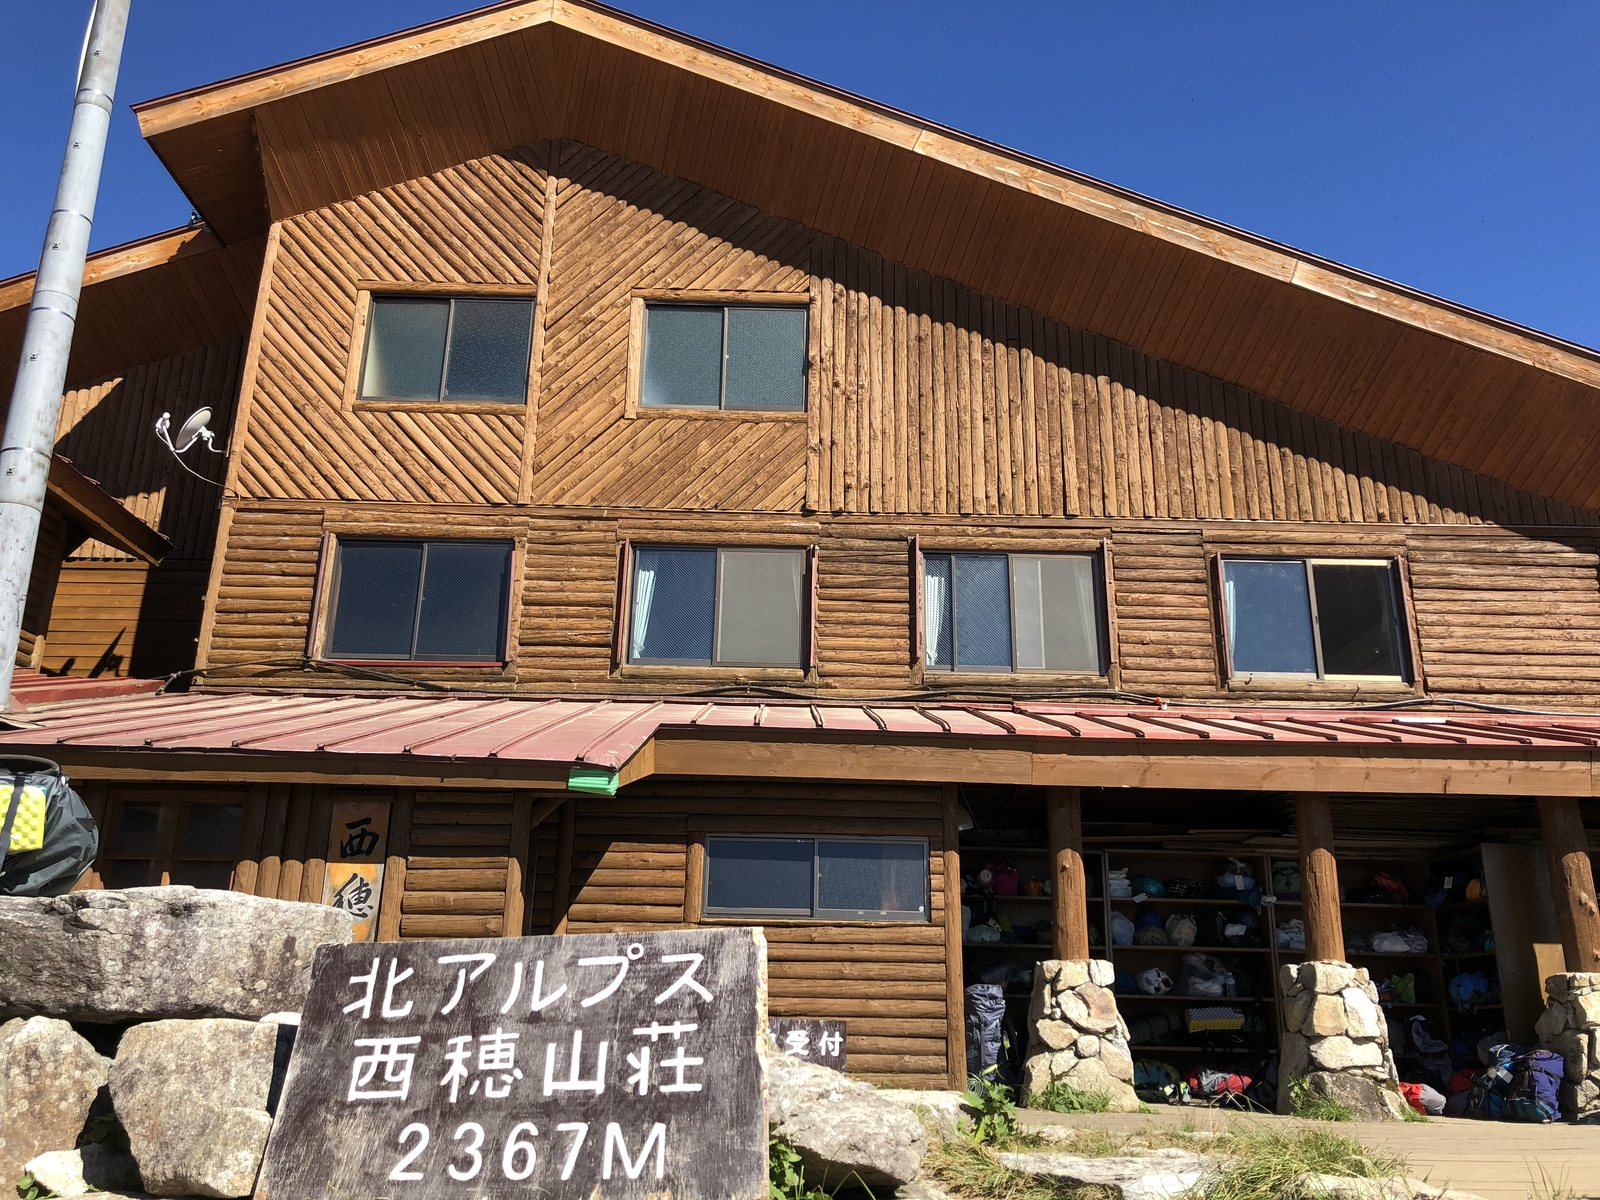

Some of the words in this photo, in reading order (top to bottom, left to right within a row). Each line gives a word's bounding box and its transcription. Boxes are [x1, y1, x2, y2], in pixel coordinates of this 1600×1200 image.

[344, 943, 713, 1019] 北アルプス
[348, 1022, 704, 1103] 西穂山荘
[769, 1029, 844, 1057] 受付
[389, 1121, 668, 1181] 2367M
